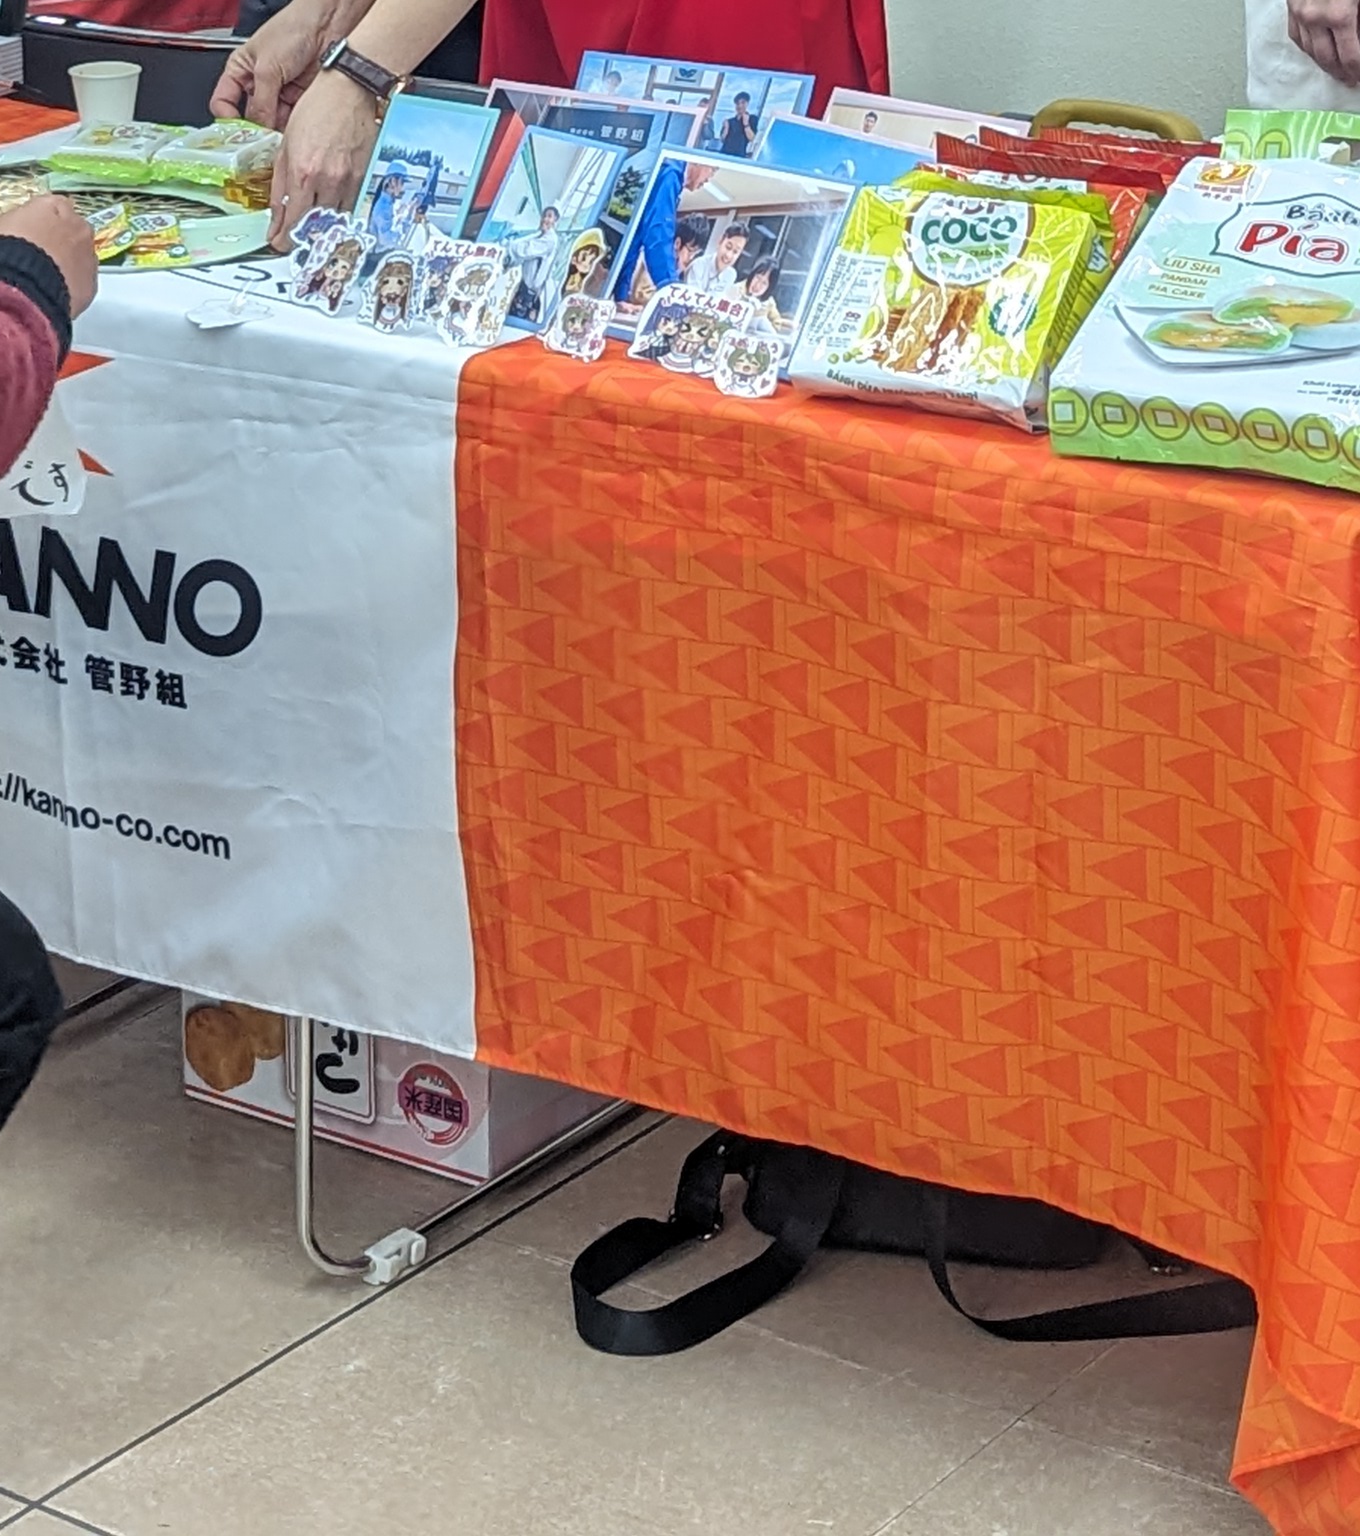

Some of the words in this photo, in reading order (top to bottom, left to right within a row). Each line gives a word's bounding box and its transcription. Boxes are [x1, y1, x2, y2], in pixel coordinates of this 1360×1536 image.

[921, 216, 1018, 245] COCO
[1162, 258, 1186, 270] LIU
[1190, 263, 1221, 276] SHA
[1161, 273, 1208, 286] PANDAN
[1172, 288, 1206, 300] CAKE
[826, 368, 854, 386] BÁNH
[86, 654, 188, 710] 管野組
[403, 1085, 463, 1124] 国産米
